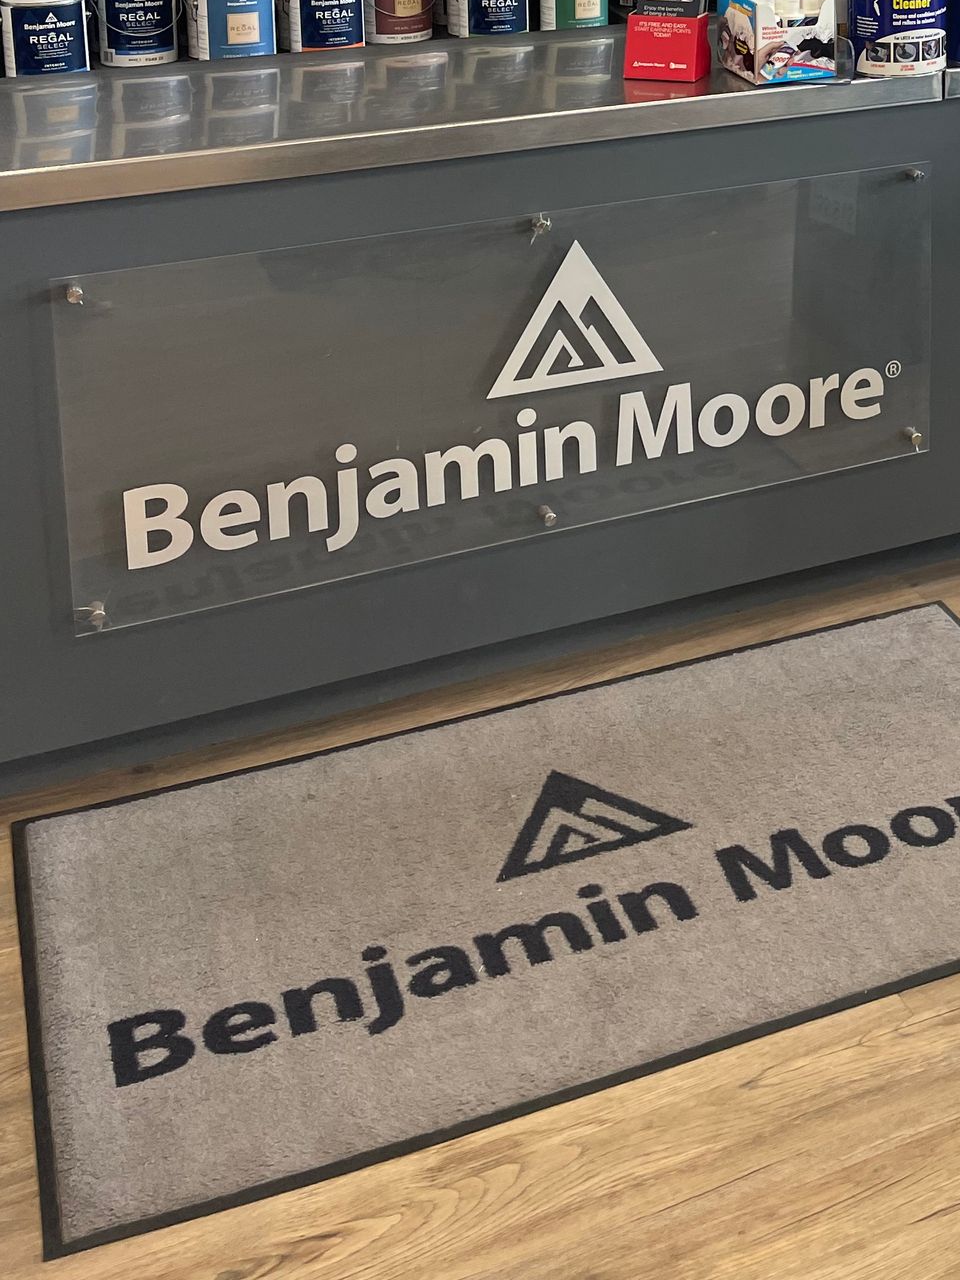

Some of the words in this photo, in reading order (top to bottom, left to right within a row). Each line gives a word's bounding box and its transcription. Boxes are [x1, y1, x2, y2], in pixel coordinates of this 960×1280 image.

[119, 13, 160, 21] REGAL
[316, 10, 354, 20] REGAL
[24, 23, 55, 31] Benjamin
[30, 33, 73, 43] REGAL
[122, 408, 597, 570] Benjamin
[106, 881, 700, 1088] Benjamin
